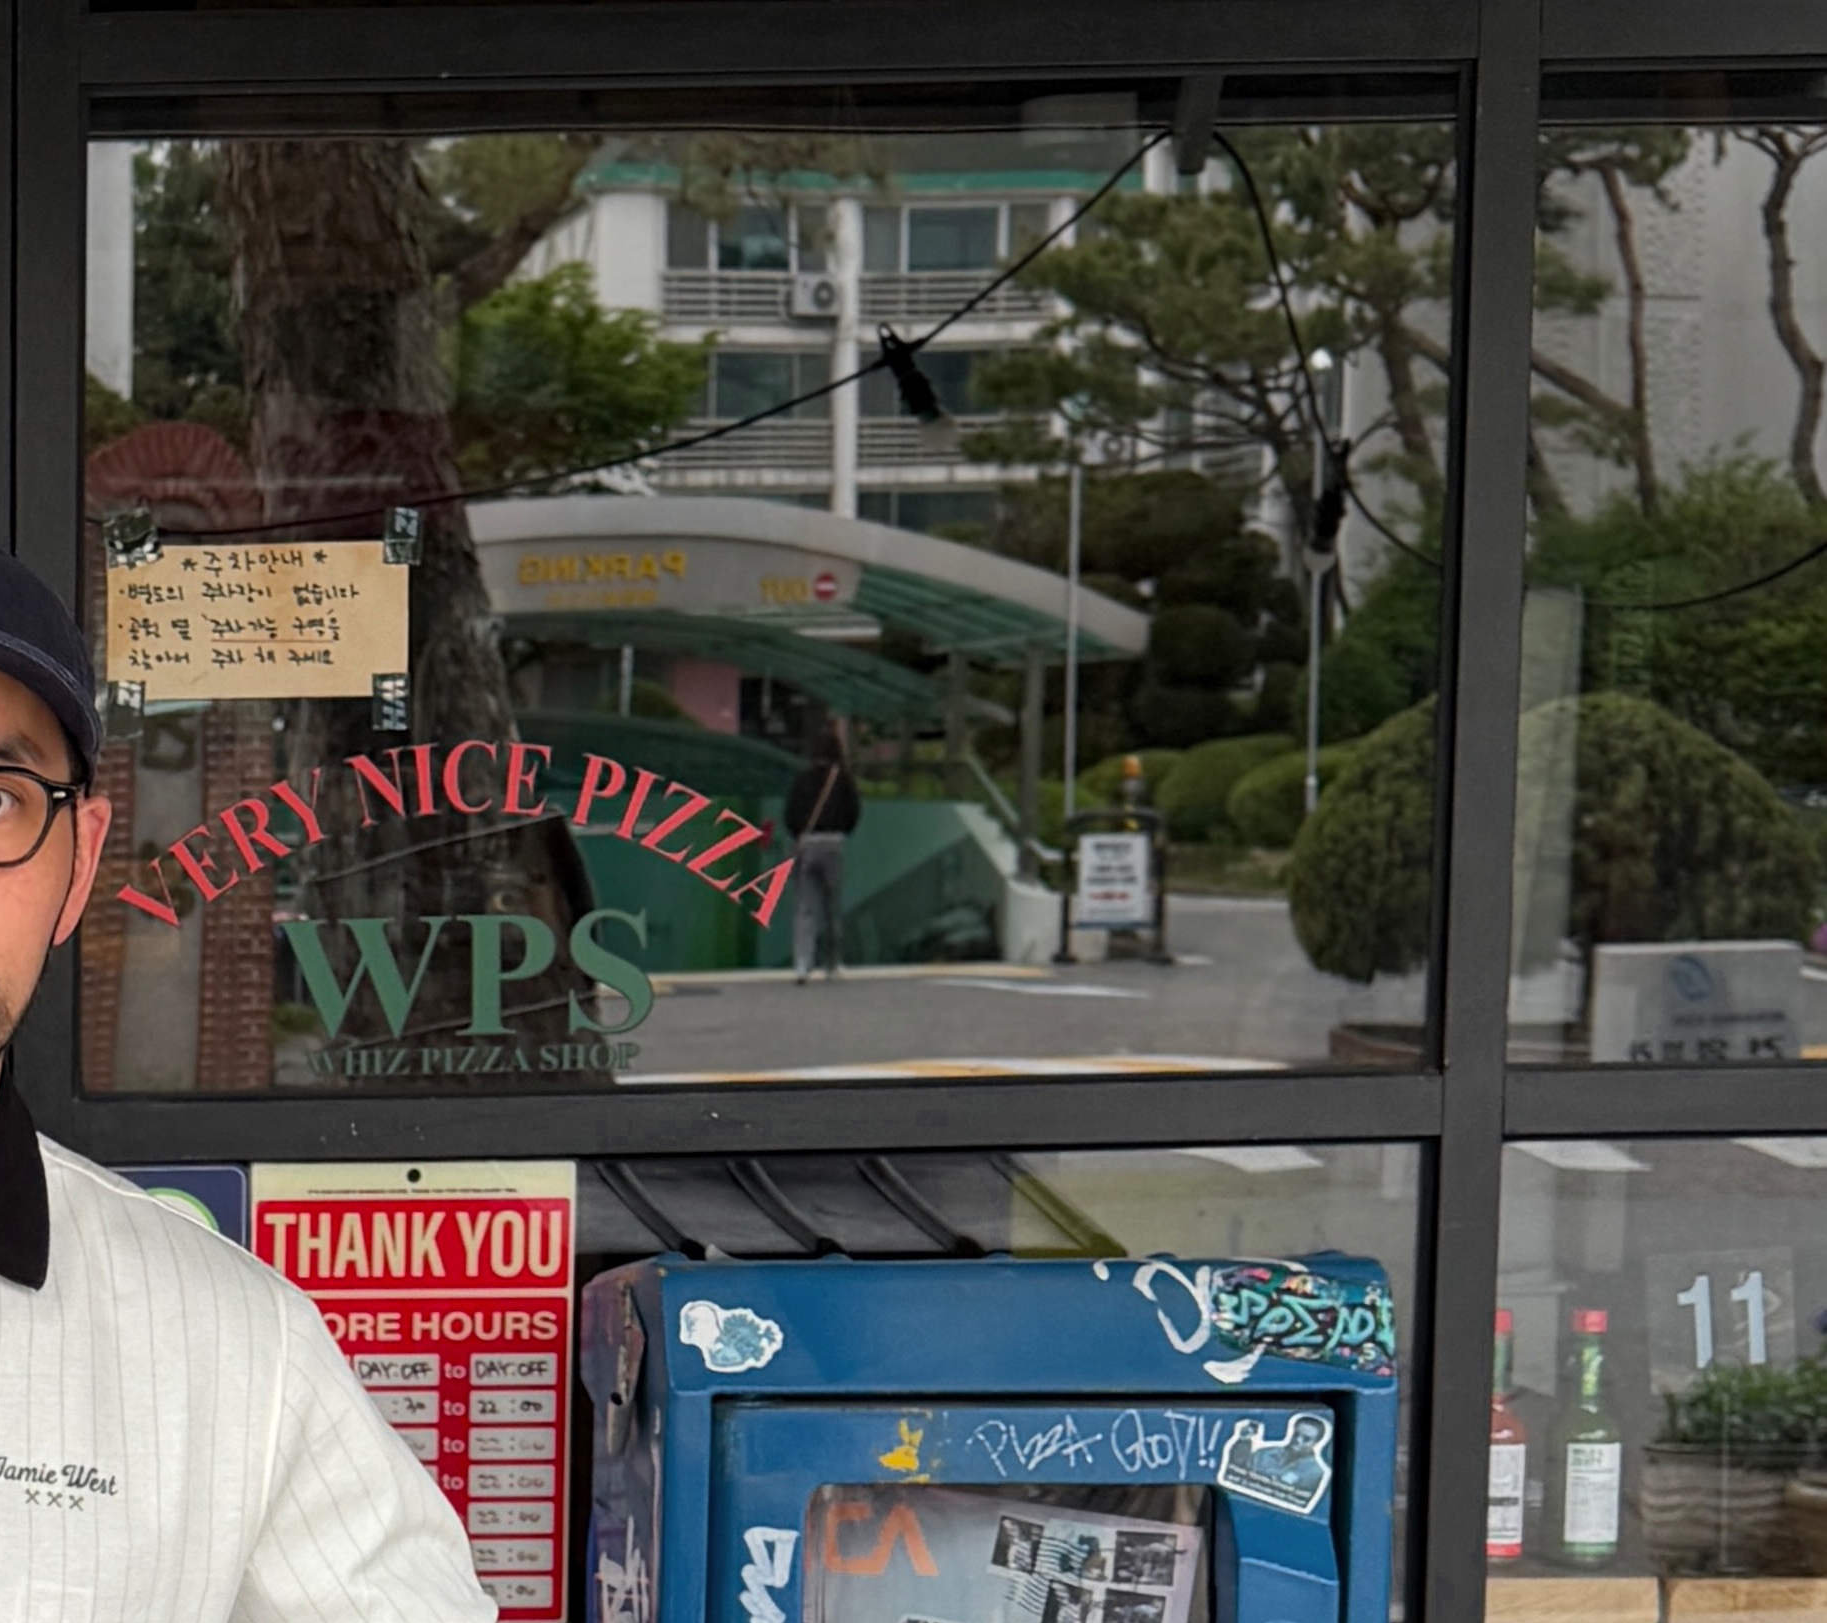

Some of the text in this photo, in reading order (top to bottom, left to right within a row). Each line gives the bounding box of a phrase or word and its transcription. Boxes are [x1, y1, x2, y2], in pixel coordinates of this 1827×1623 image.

[202, 549, 304, 578] 주차안내
[201, 580, 272, 602] 주차장이
[292, 583, 360, 607] 없습니다
[117, 739, 796, 928] VERY NICE PIZZA
[280, 908, 654, 1040] WPS
[306, 1041, 640, 1078] WHIZ PIZZA SHOP
[264, 1209, 562, 1279] THANK YOU
[323, 1311, 558, 1341] ORE HOURS
[444, 1362, 466, 1379] to
[443, 1399, 465, 1416] to
[443, 1436, 465, 1453] to
[62, 1464, 118, 1497] West
[442, 1473, 464, 1490] to
